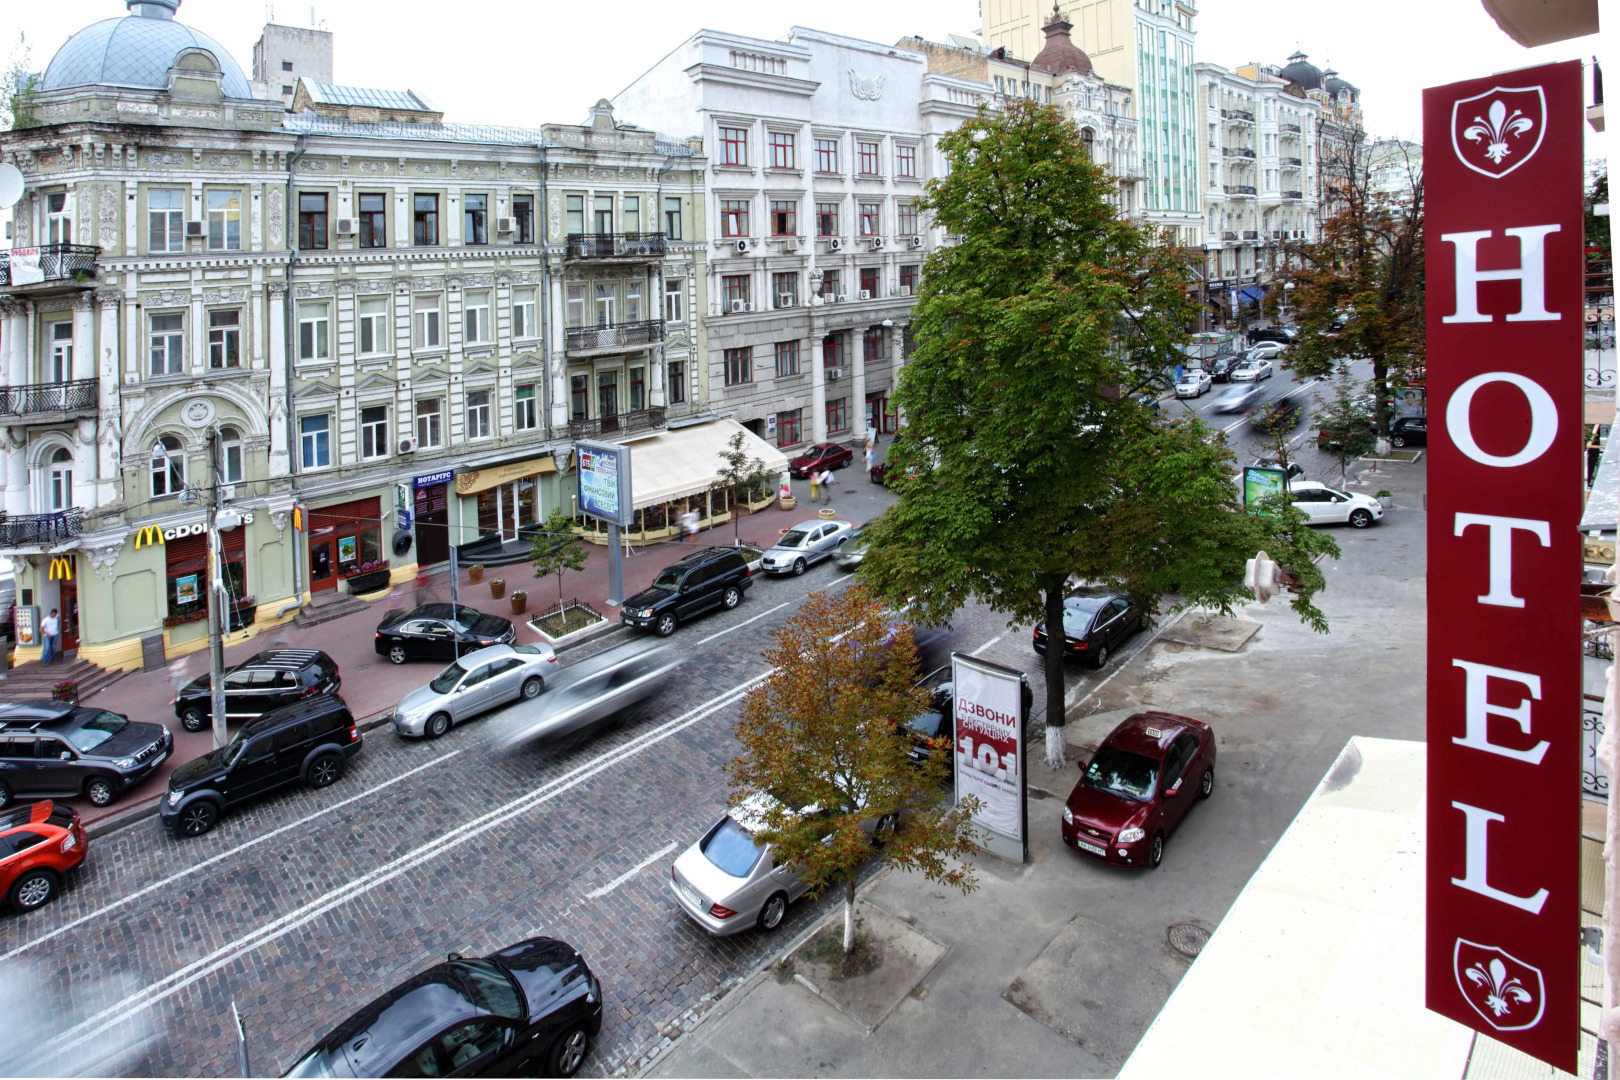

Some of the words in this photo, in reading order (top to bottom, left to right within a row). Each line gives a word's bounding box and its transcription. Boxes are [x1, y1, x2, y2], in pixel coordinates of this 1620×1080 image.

[417, 471, 451, 484] НОТАРІУС
[1441, 223, 1561, 915] HOTEL
[958, 698, 1016, 728] ДЗВОНИ
[959, 735, 1016, 786] 101
